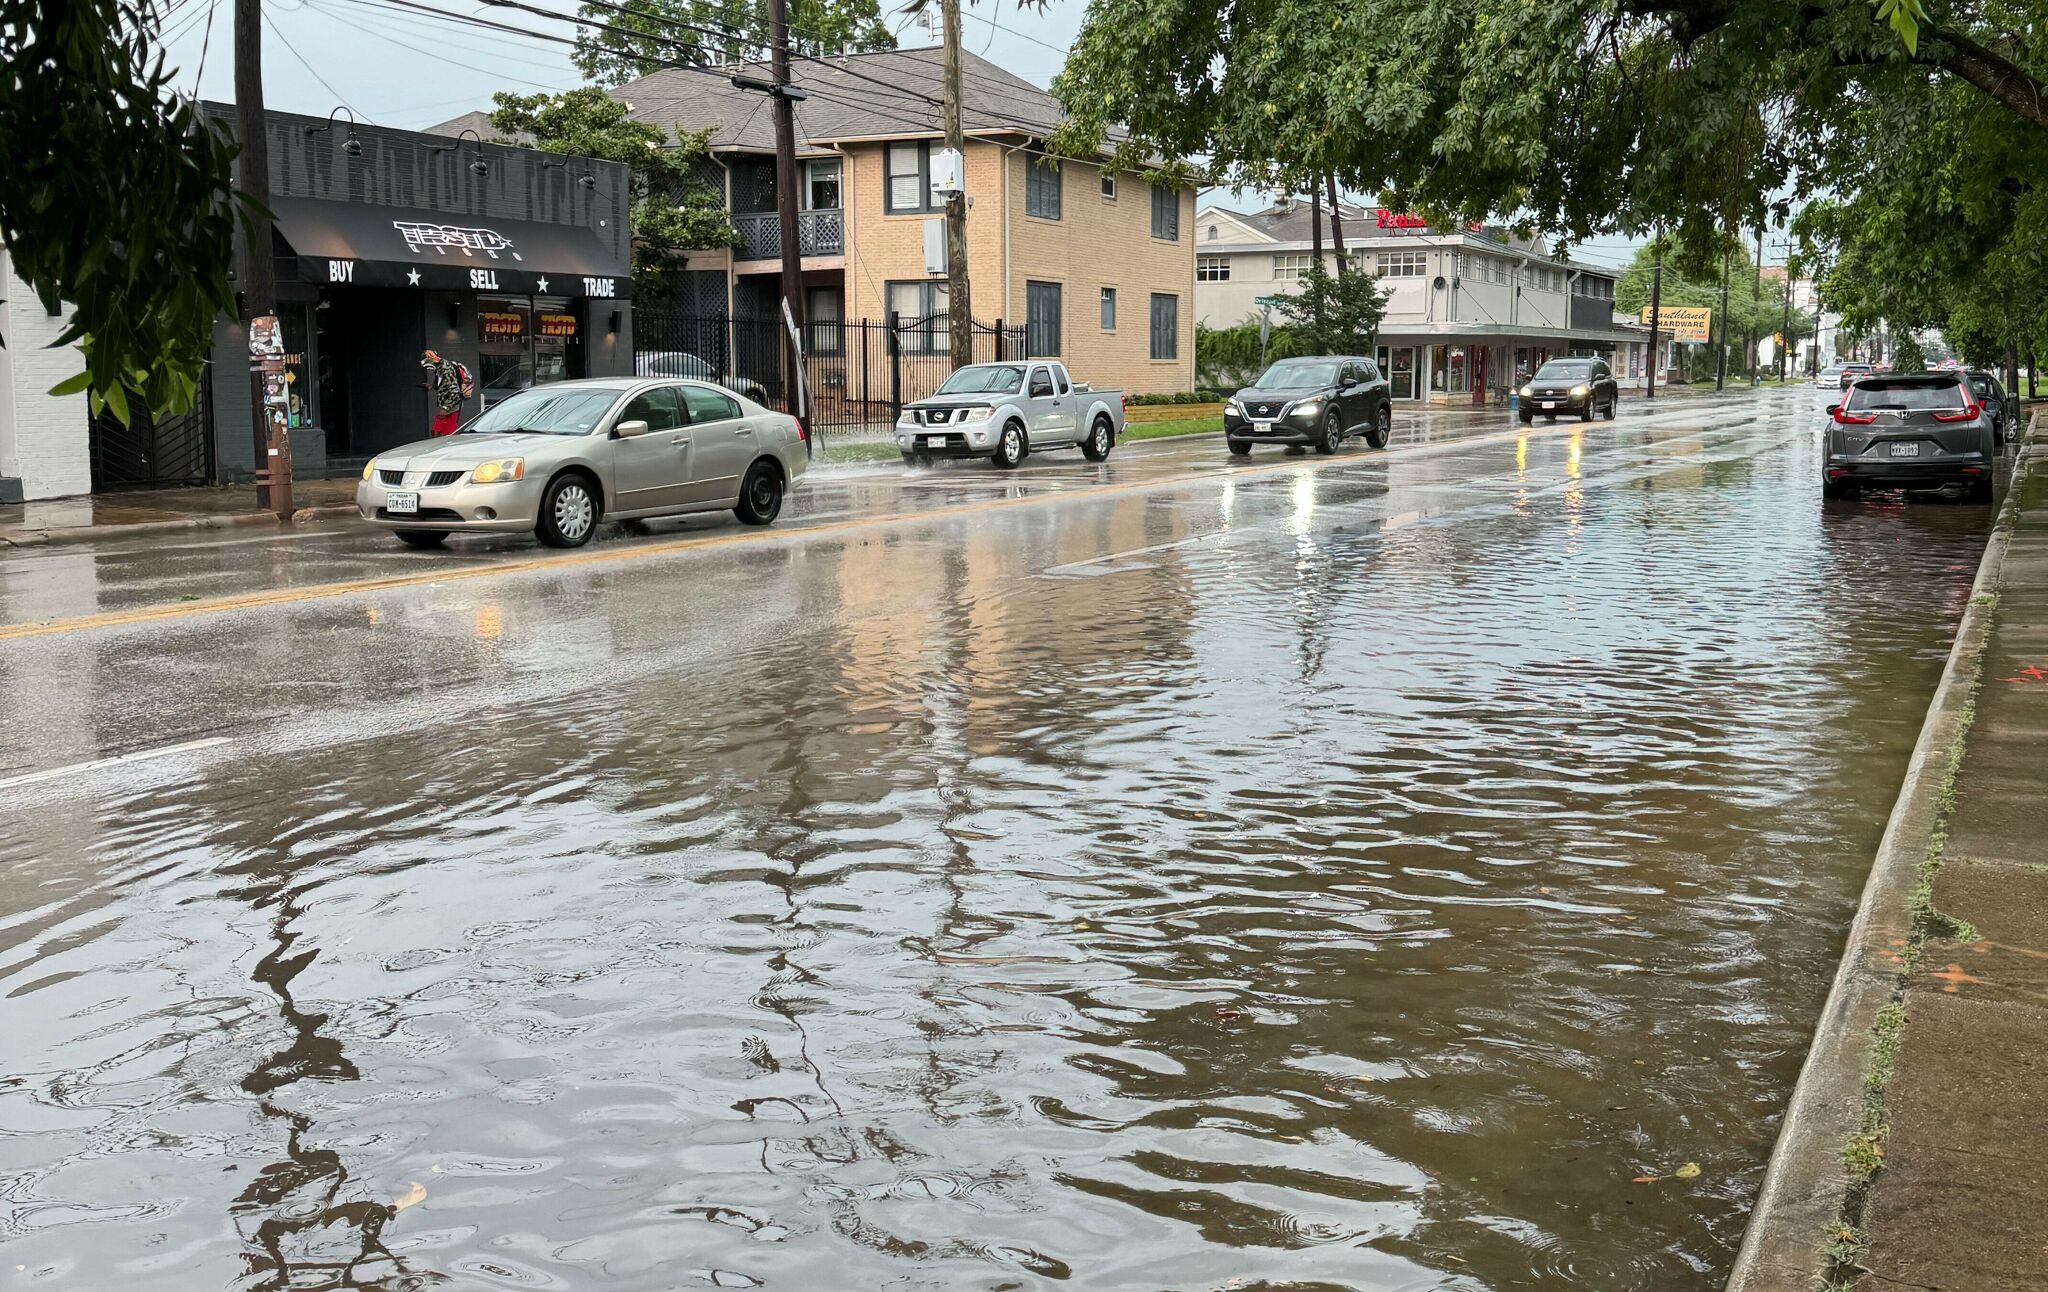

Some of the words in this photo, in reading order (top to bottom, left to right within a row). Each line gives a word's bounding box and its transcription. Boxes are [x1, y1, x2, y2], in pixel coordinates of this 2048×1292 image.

[329, 260, 354, 282] BUY
[470, 268, 499, 290] SELL
[583, 277, 615, 297] TRADE
